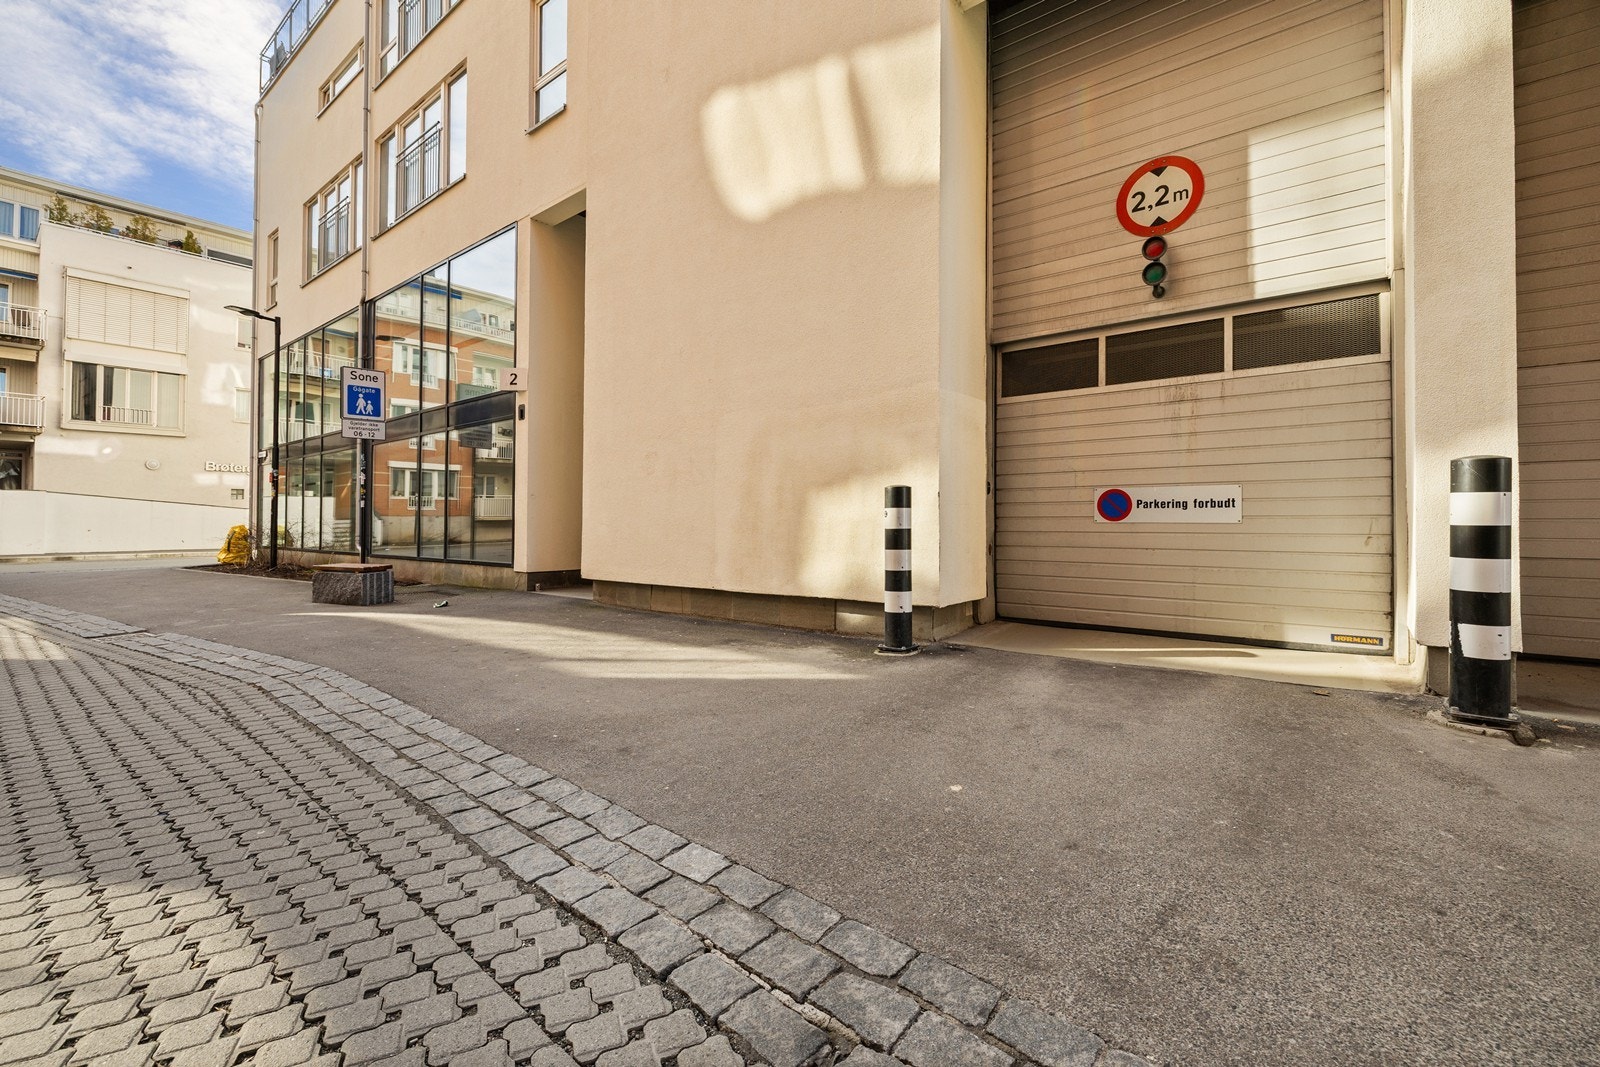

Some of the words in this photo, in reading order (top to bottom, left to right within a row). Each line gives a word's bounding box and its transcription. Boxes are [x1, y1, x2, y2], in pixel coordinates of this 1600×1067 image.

[350, 371, 379, 383] Sone
[509, 373, 518, 386] 2
[1136, 499, 1188, 510] Parkering
[1193, 498, 1236, 508] forbudt
